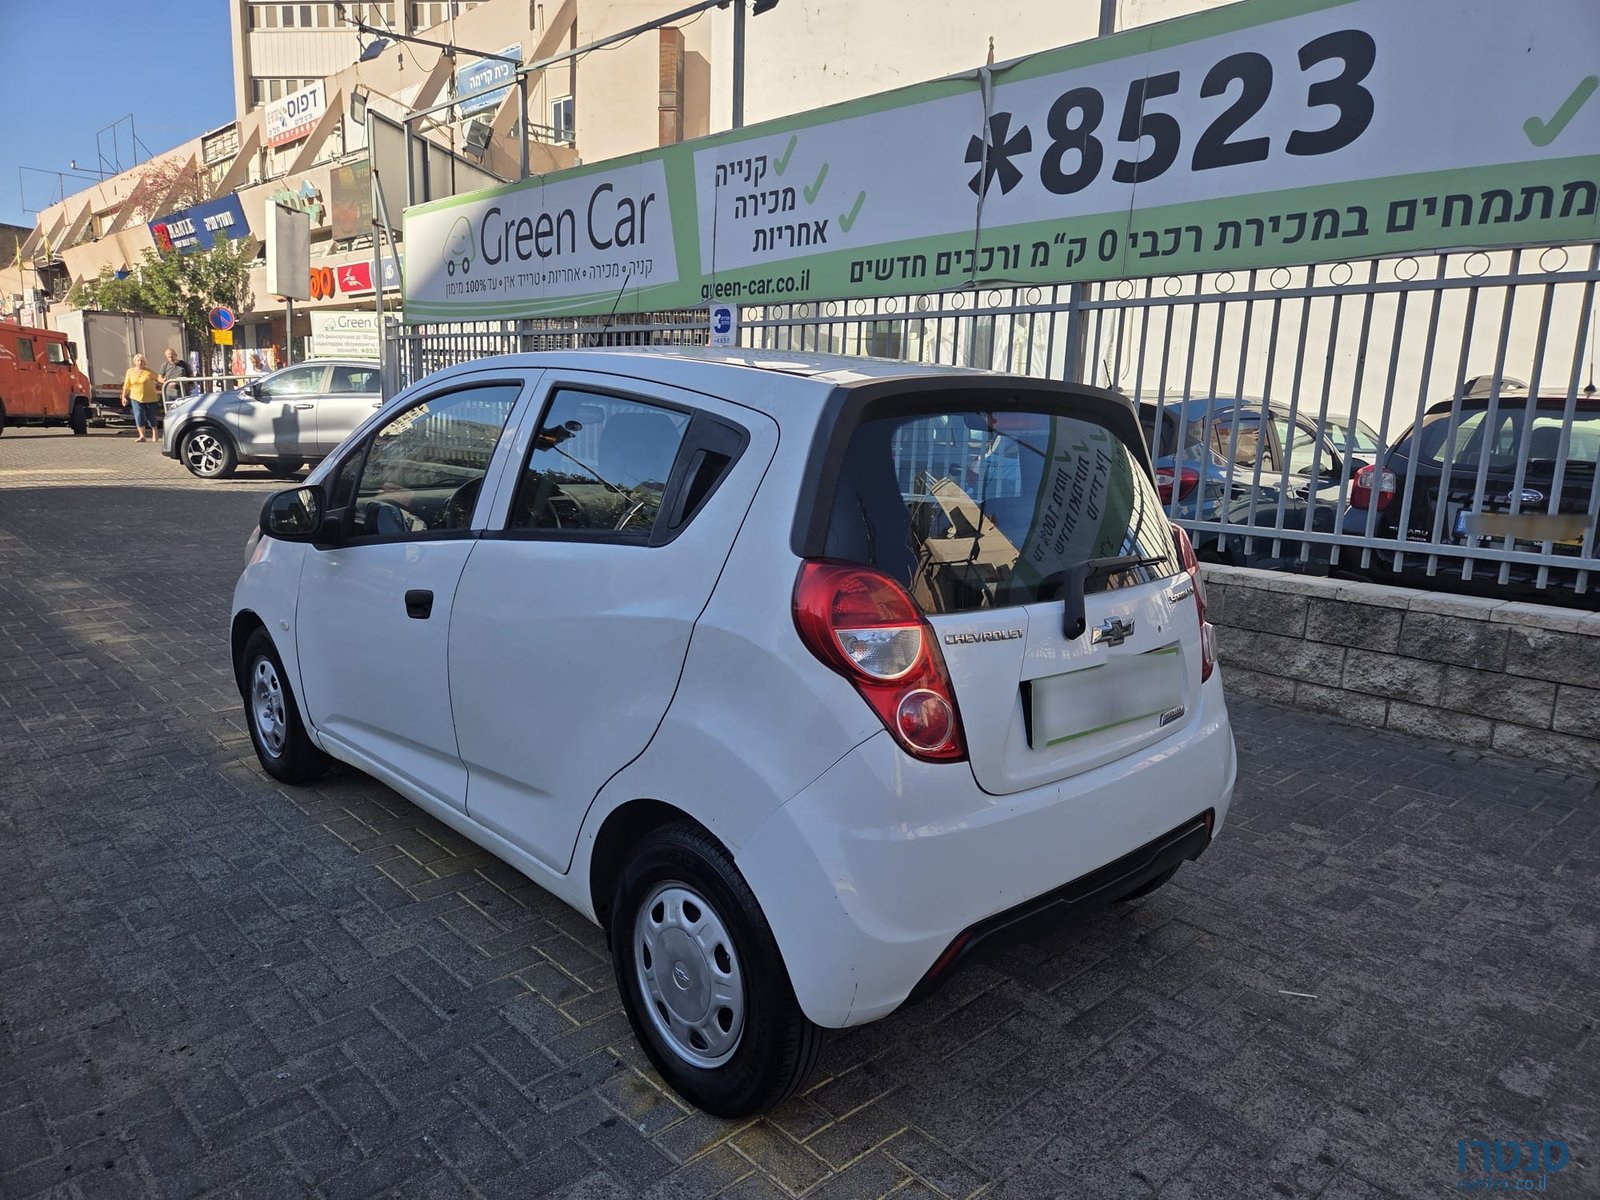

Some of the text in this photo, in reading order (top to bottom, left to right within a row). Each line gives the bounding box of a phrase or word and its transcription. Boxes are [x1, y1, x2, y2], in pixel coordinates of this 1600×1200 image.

[287, 89, 317, 118] דפוס
[716, 155, 767, 187] קנייה
[735, 187, 796, 219] מכירה
[1386, 180, 1598, 234] מתמחים
[480, 182, 655, 266] Green Car
[753, 219, 829, 252] אחריות
[1214, 205, 1369, 251] במכירת
[1128, 225, 1203, 259] רכבי
[850, 254, 927, 283] חדשים
[935, 243, 1021, 277] ורכבים
[445, 258, 653, 298] קניה מכירה אחריות טרייד אין עד 100% מימון
[701, 268, 810, 300] green-car.co.il
[337, 315, 371, 328] Green
[944, 628, 1024, 645] CHEVROLET
